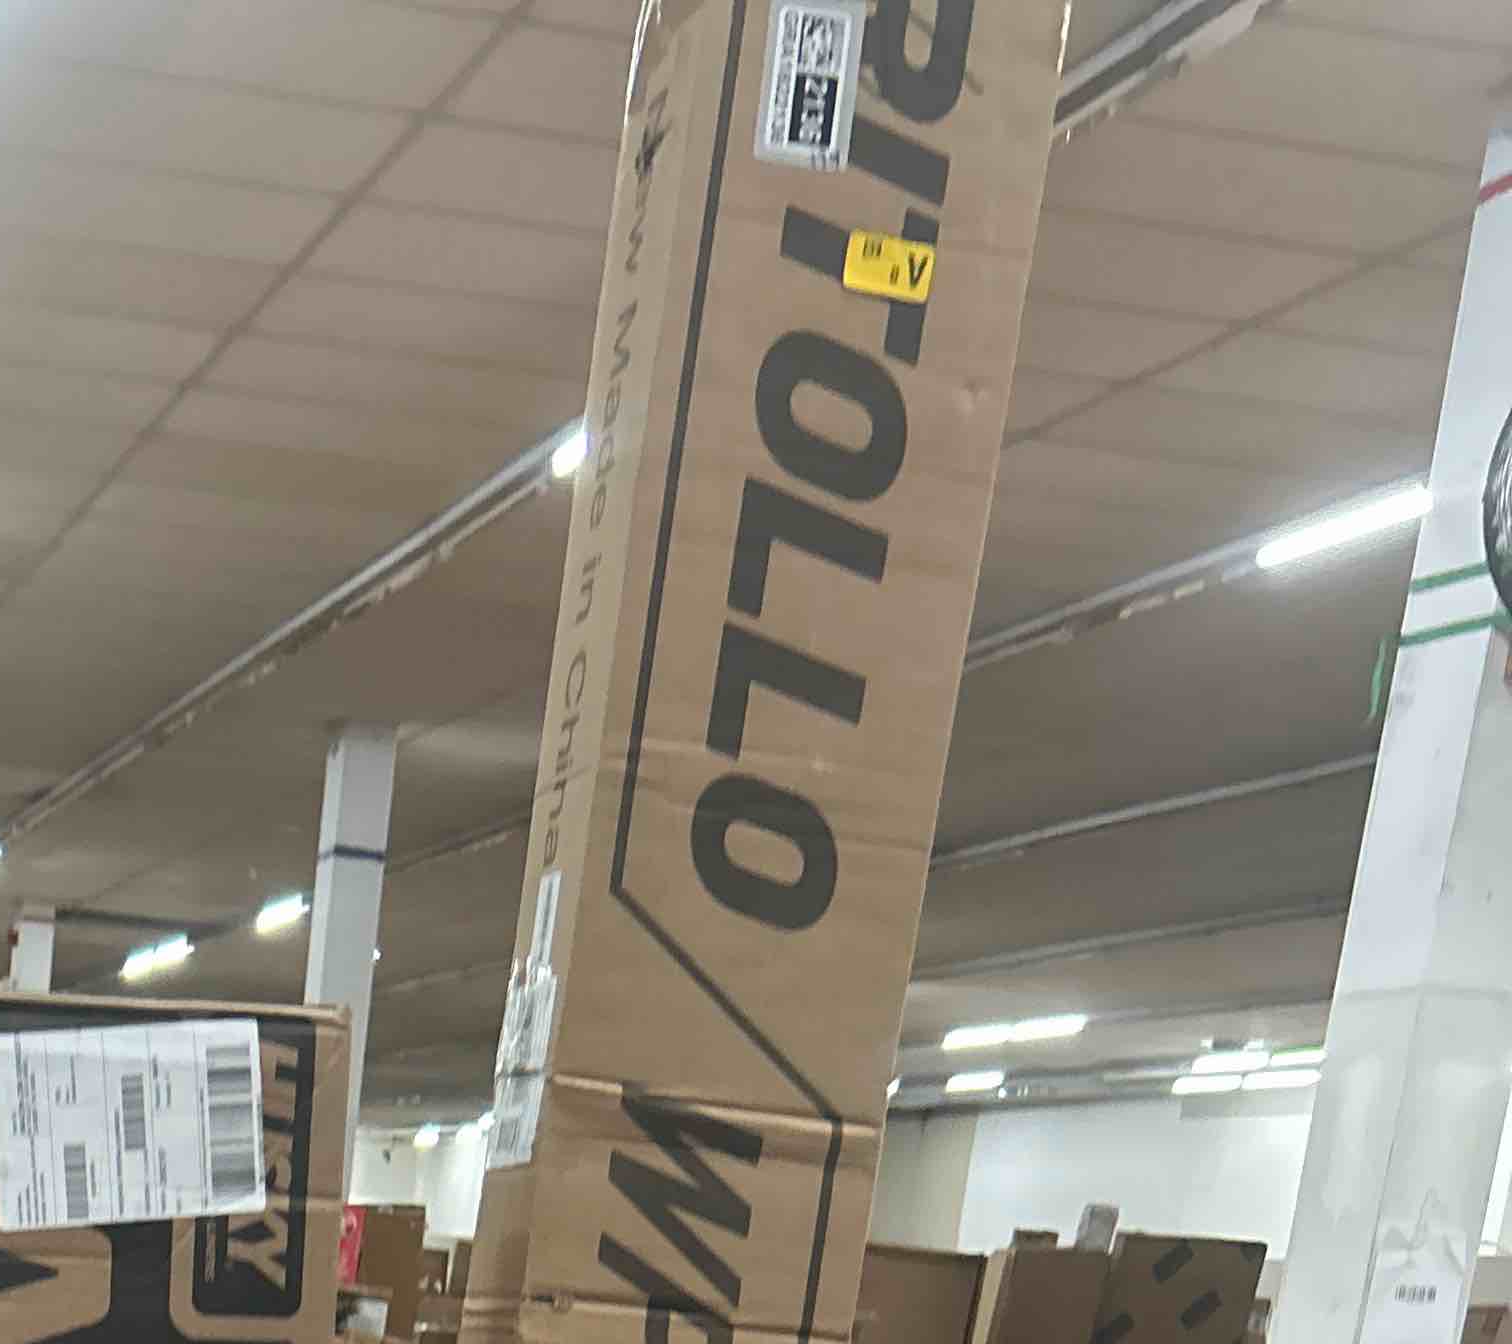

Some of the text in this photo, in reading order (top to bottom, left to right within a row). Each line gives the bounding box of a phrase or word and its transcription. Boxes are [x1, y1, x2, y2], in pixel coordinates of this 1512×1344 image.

[543, 300, 639, 870] Made in China
